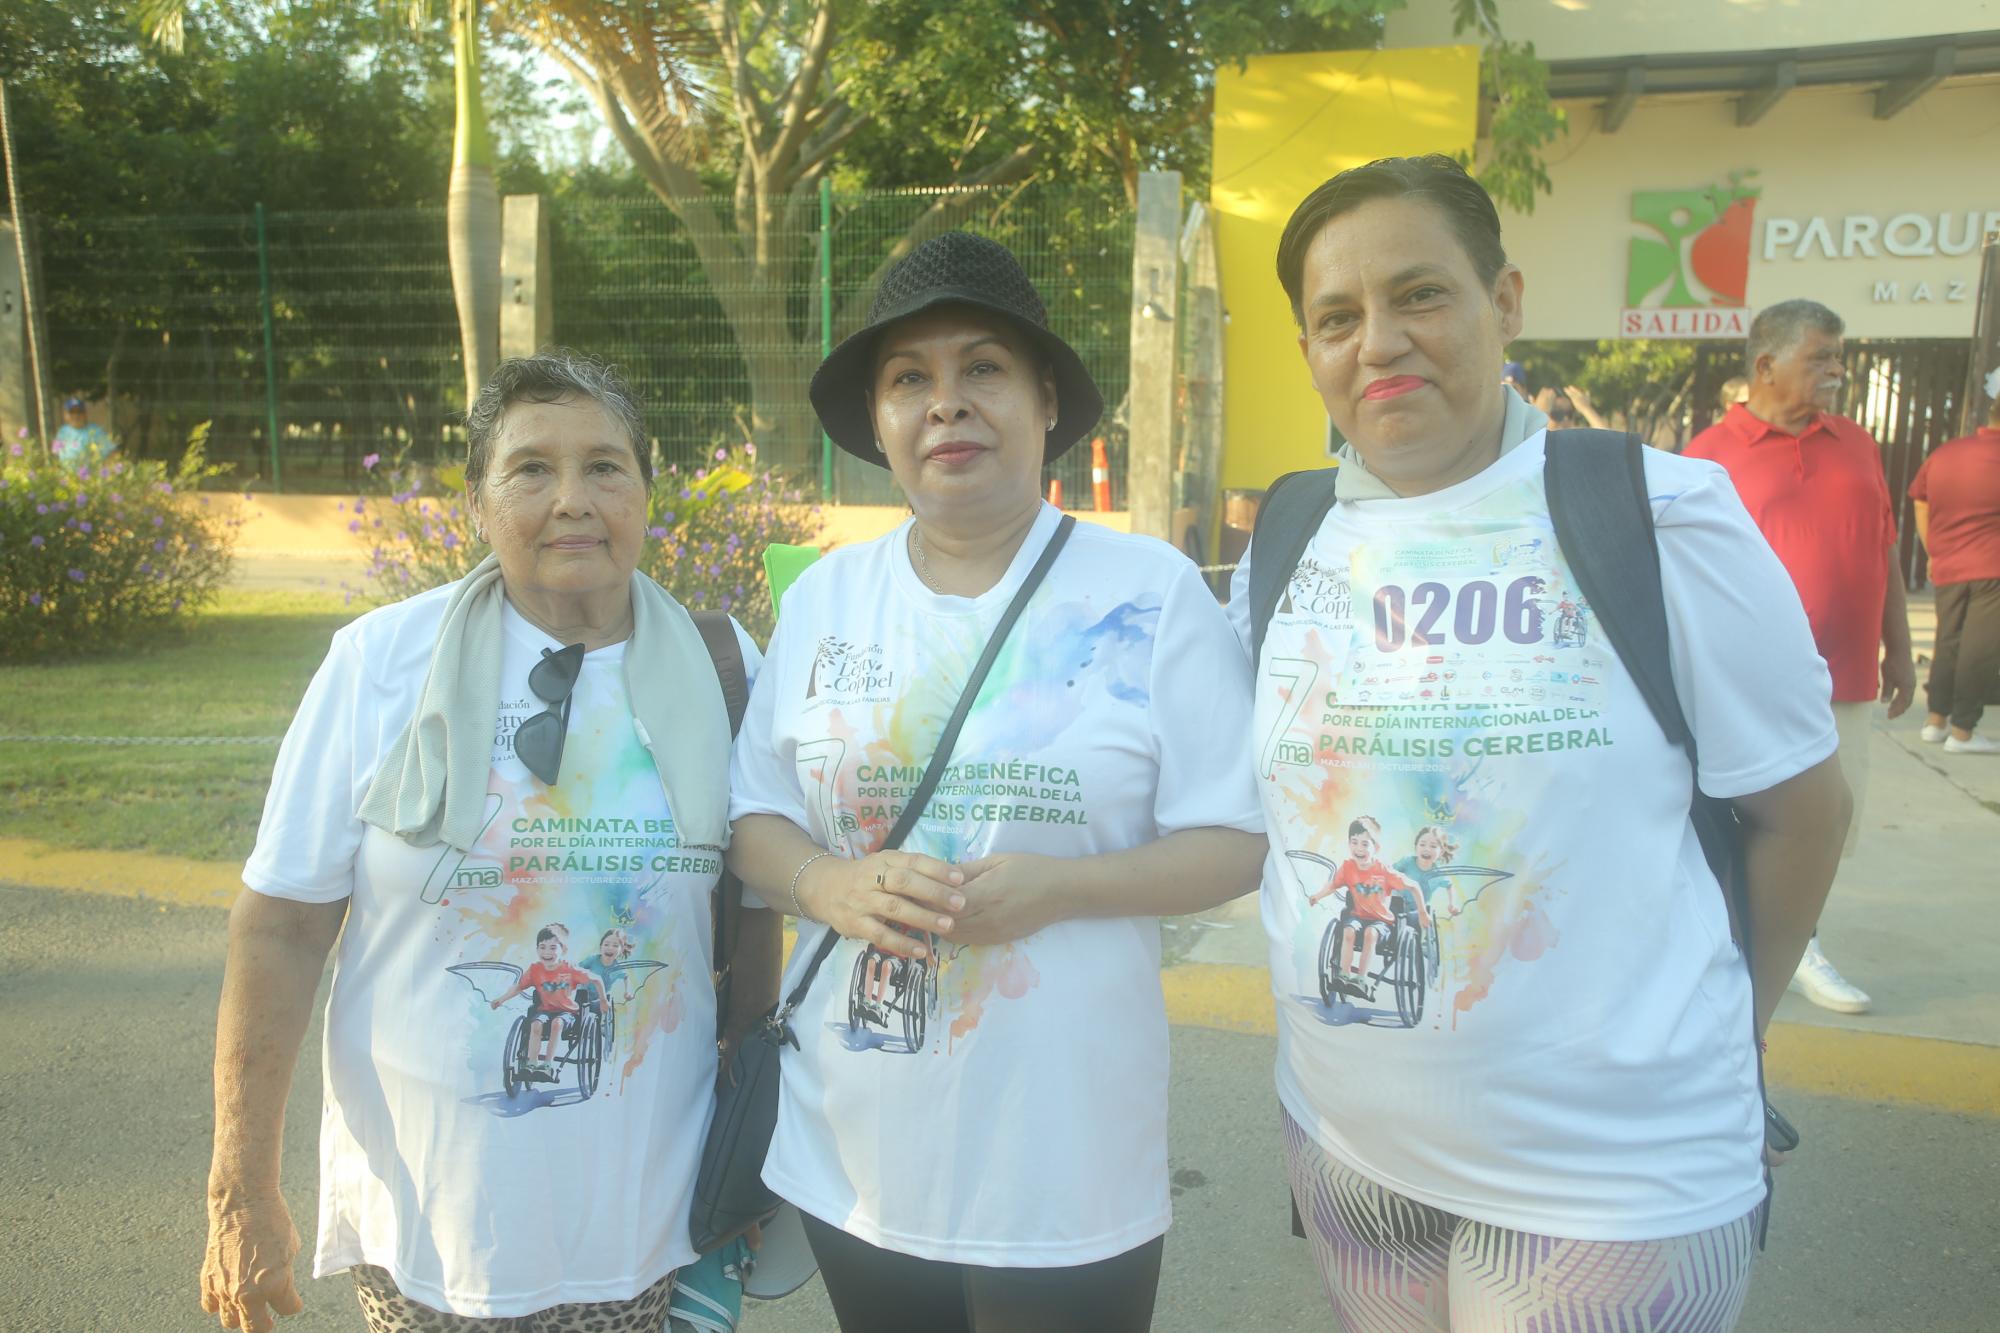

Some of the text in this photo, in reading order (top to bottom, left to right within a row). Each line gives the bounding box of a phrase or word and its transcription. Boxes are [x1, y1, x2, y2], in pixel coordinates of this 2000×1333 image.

[1625, 311, 1744, 334] SALIDA
[1373, 575, 1546, 653] 0206
[1321, 713, 1352, 727] POR
[1354, 714, 1373, 728] EL
[1375, 712, 1402, 729] DÍA
[1404, 709, 1552, 729] INTERNACIONAL
[1553, 708, 1577, 721] DE
[1319, 727, 1614, 757] PARÁLISIS CEREBRAL
[856, 757, 1080, 785] CAMINTA BENÉFICA
[857, 786, 888, 798] POR
[891, 787, 906, 797] EL
[1040, 787, 1062, 801] DE
[1064, 790, 1082, 802] LA
[971, 804, 1088, 825] CEREBRAL
[511, 817, 639, 834] CAMINATA
[511, 836, 545, 848] POR
[547, 837, 567, 848] EL
[569, 834, 594, 848] DÍA
[509, 851, 644, 872] PARÁLISIS
